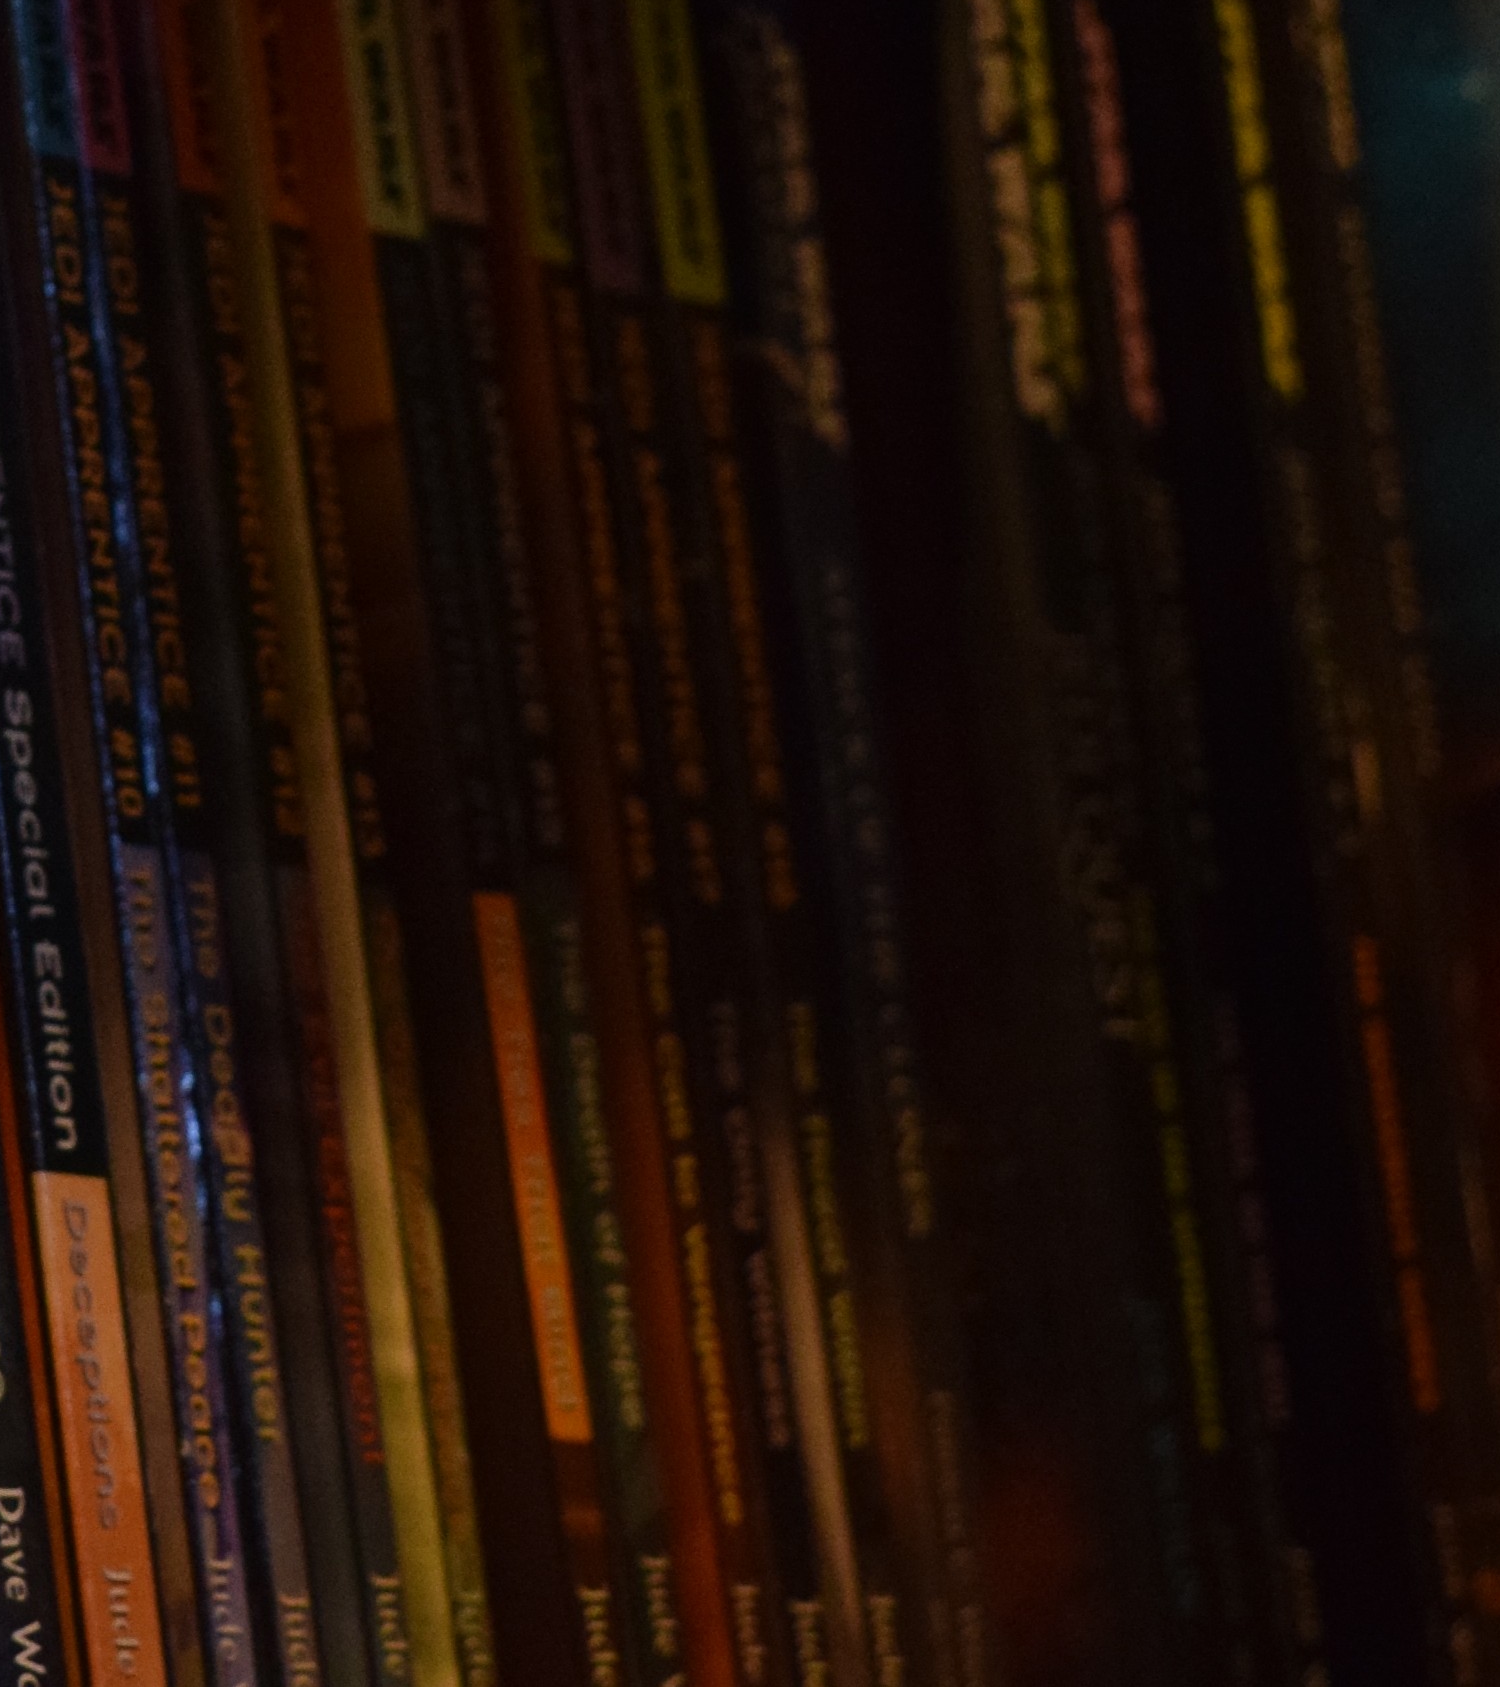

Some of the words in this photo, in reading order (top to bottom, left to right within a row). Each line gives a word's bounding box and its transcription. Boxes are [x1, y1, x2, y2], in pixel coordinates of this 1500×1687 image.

[47, 177, 84, 305] JEDI
[101, 194, 139, 317] JEDI
[62, 321, 133, 708] APPRENTICE
[118, 334, 193, 712] APPRENTICE
[109, 727, 145, 818] #10
[1, 687, 58, 923] Special
[31, 940, 80, 1153] Edition
[188, 879, 220, 980] The
[233, 1240, 281, 1443] Hunter
[60, 1198, 121, 1531] Deceptions
[102, 1567, 141, 1678] Jude
[206, 1557, 245, 1662] Jude
[369, 1571, 408, 1678] Jude
